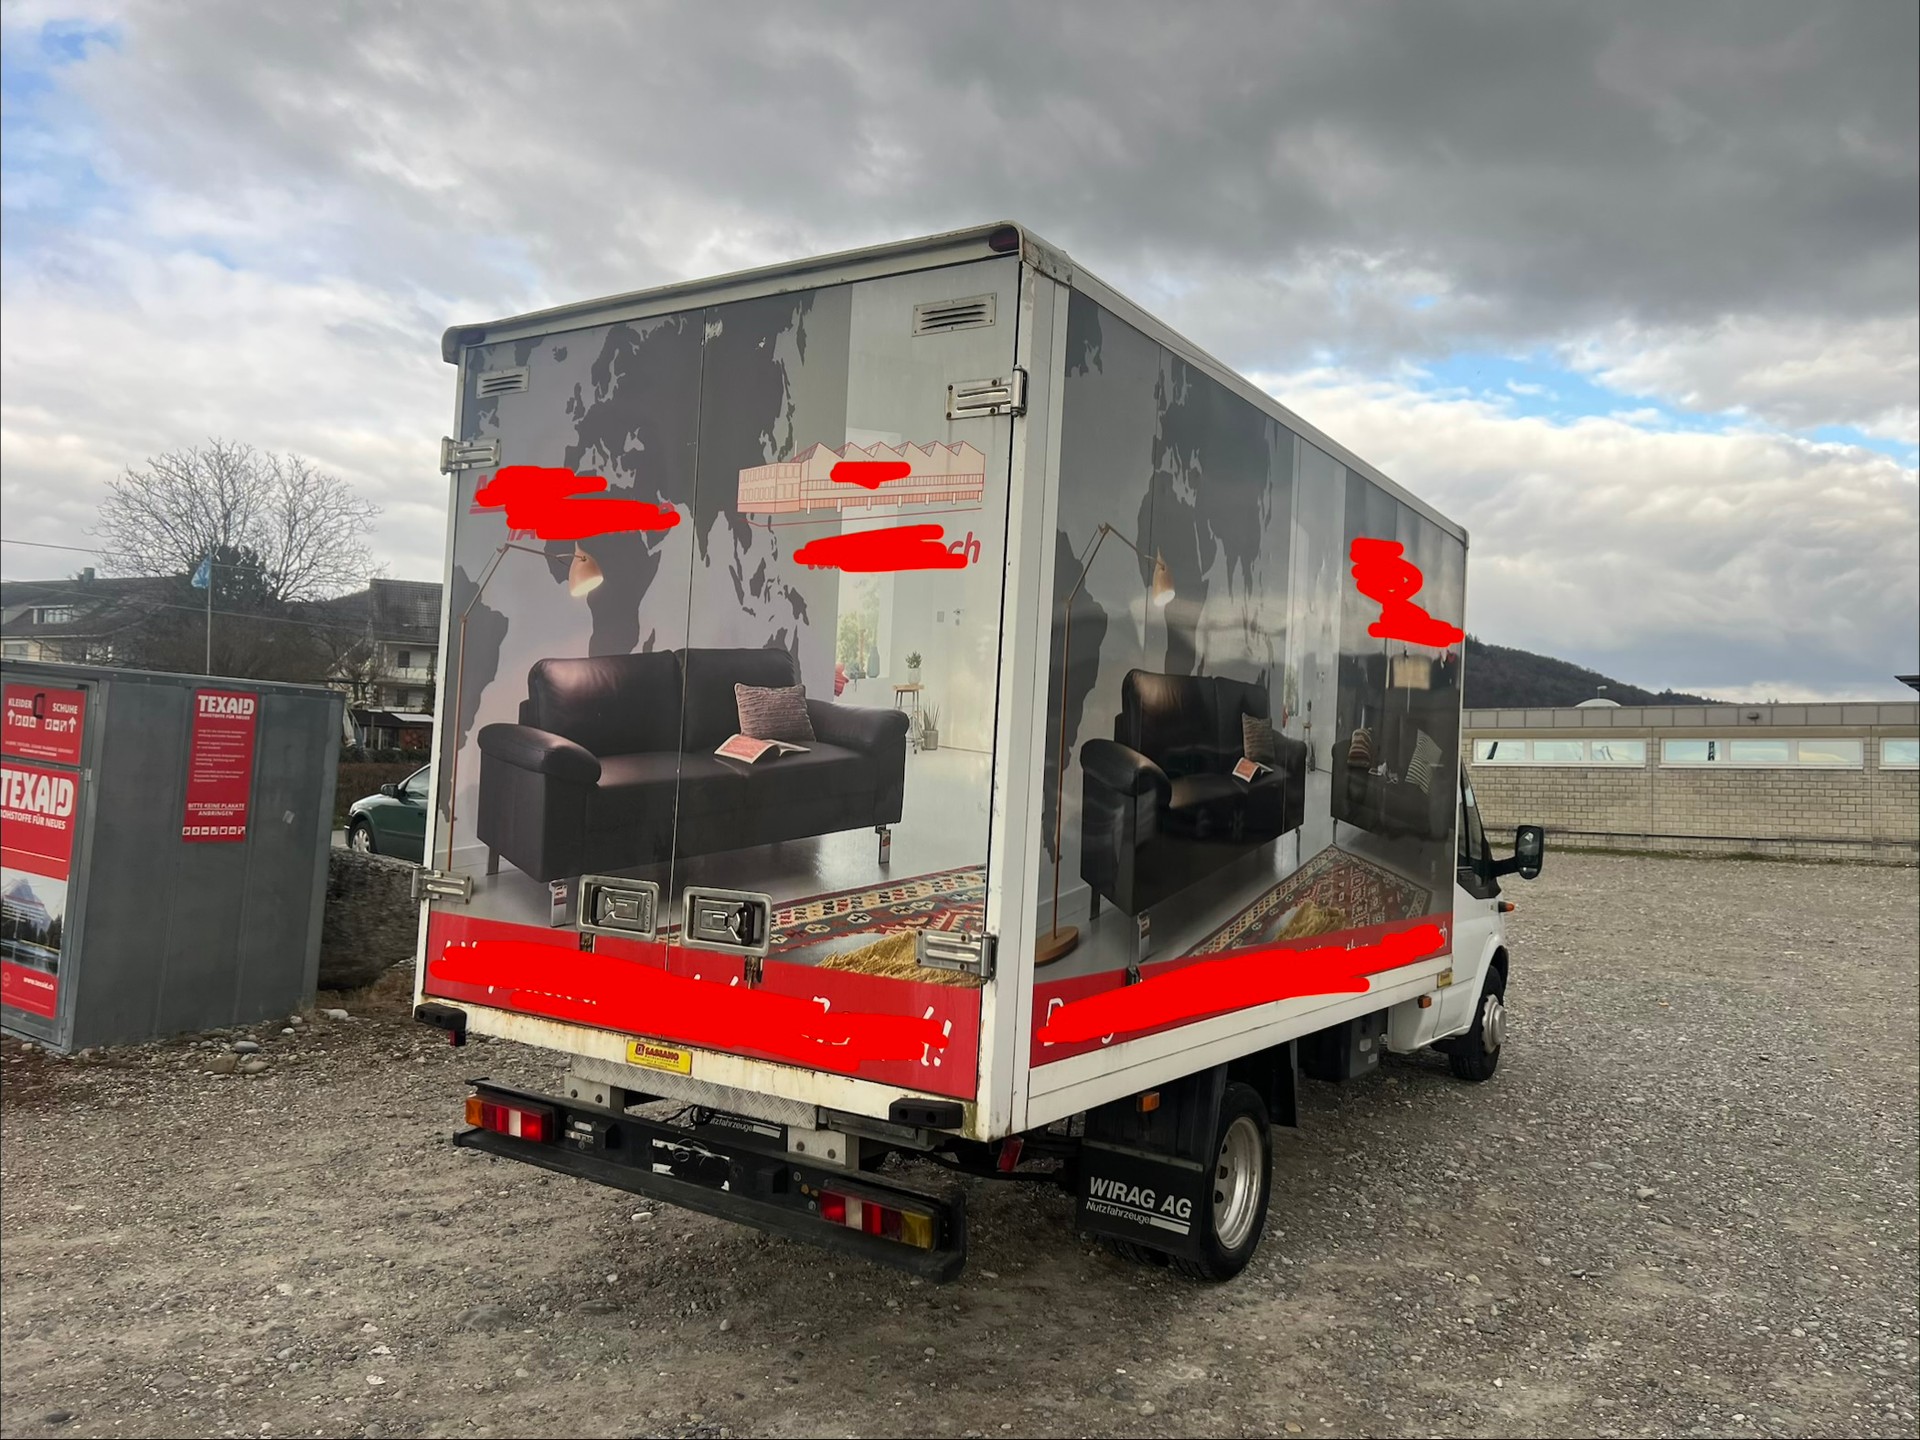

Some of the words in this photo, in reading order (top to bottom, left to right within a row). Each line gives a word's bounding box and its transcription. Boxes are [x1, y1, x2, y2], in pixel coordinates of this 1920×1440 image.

[8, 698, 33, 709] KLEIDER
[52, 703, 78, 714] SCHUHE
[198, 695, 255, 715] TEXAID
[1, 768, 74, 817] TEXAID
[32, 813, 45, 826] FÜR
[45, 817, 66, 830] NEUES
[1090, 1176, 1156, 1209] WIRAG
[1160, 1194, 1192, 1219] AG
[1086, 1200, 1151, 1225] Nutzfahrzeuge
